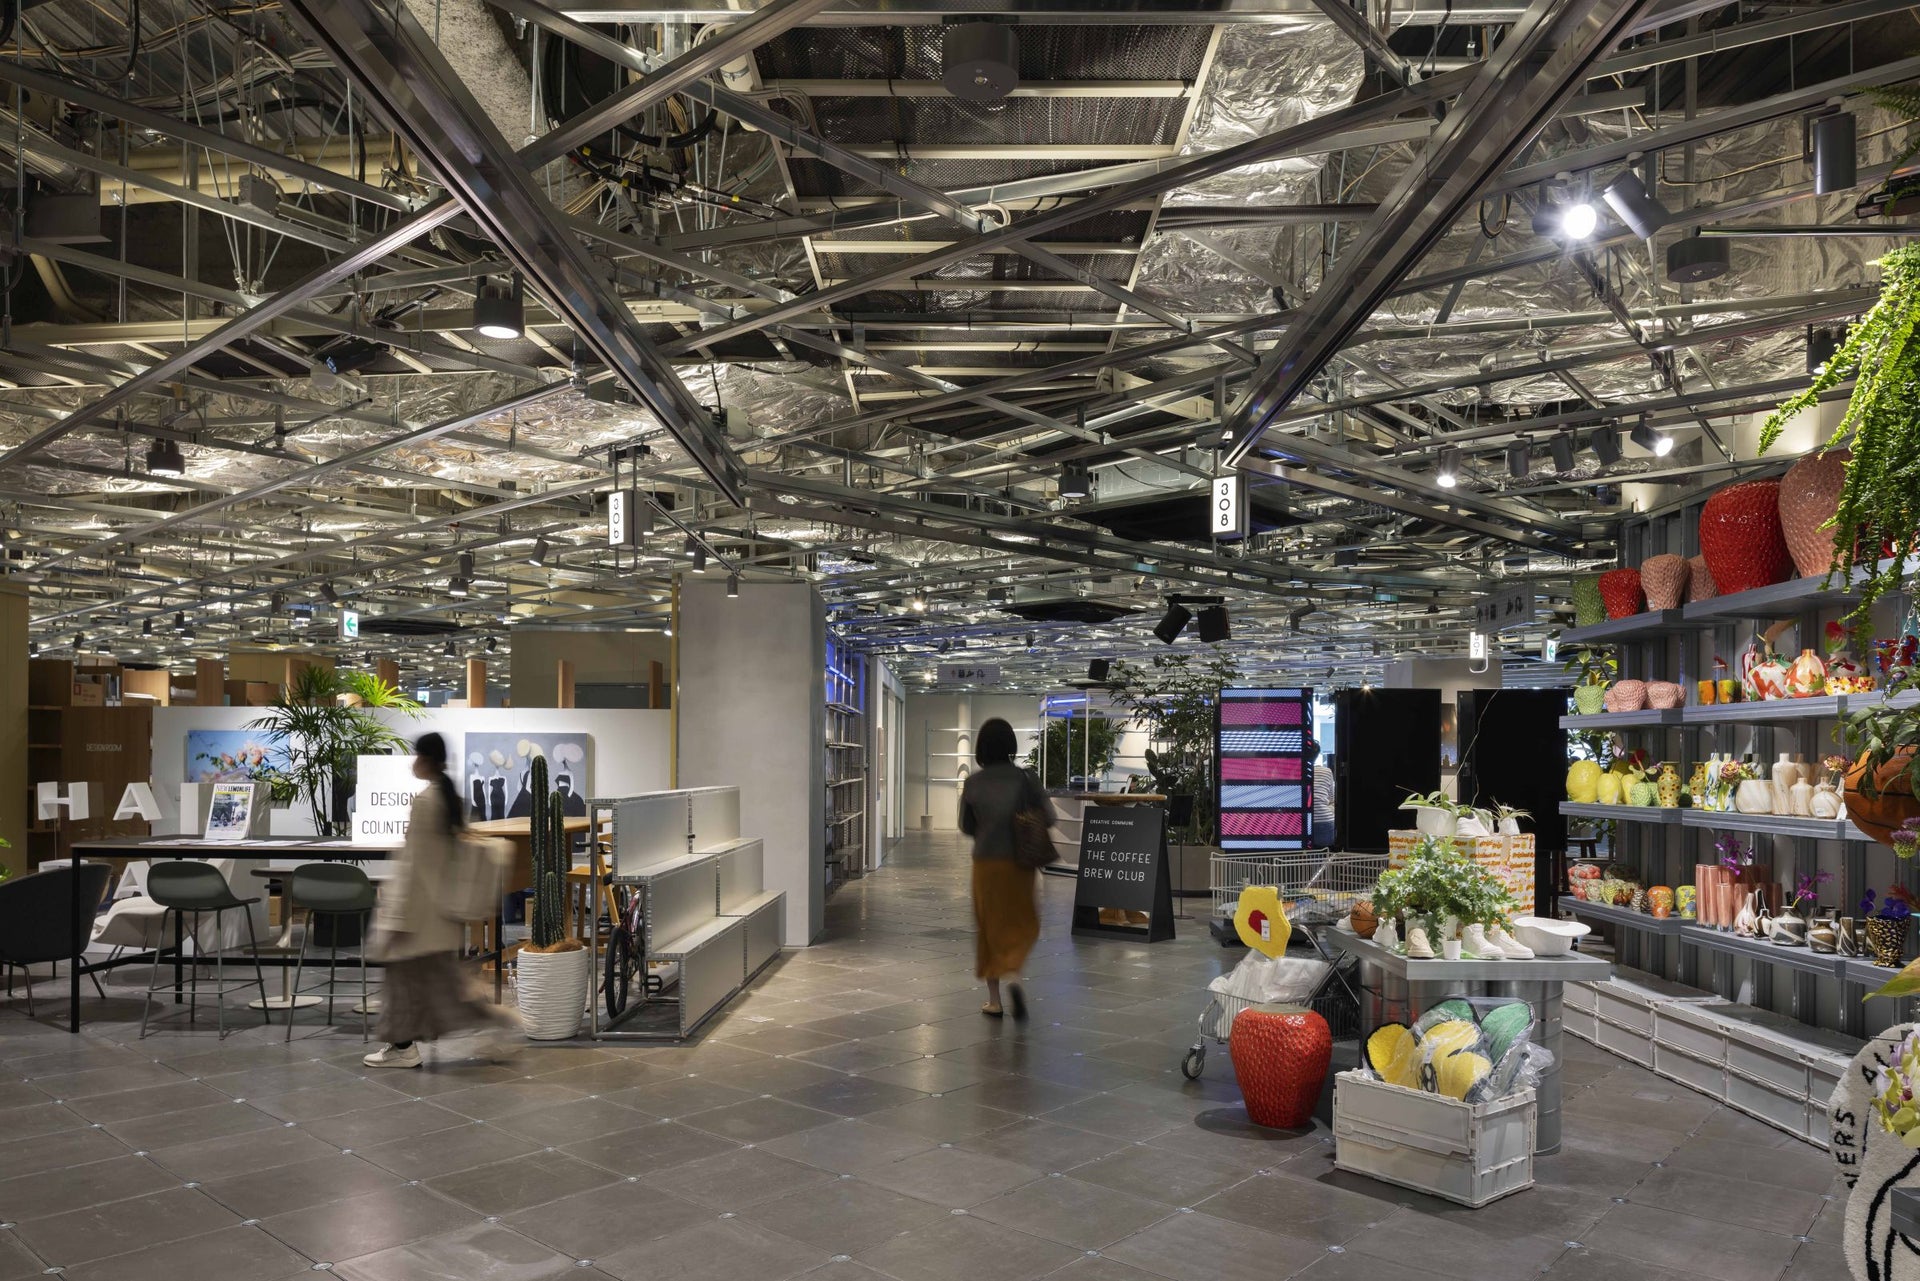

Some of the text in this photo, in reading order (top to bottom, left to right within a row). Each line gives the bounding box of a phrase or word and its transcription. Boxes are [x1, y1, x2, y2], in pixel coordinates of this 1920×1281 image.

[1219, 482, 1231, 527] 308
[612, 498, 620, 539] 306
[371, 792, 417, 806] DESIGN
[361, 820, 410, 835] COUNTE
[1087, 832, 1116, 843] BABY
[1087, 850, 1151, 864] THE COFFEE
[1084, 867, 1145, 882] BREW CLUB
